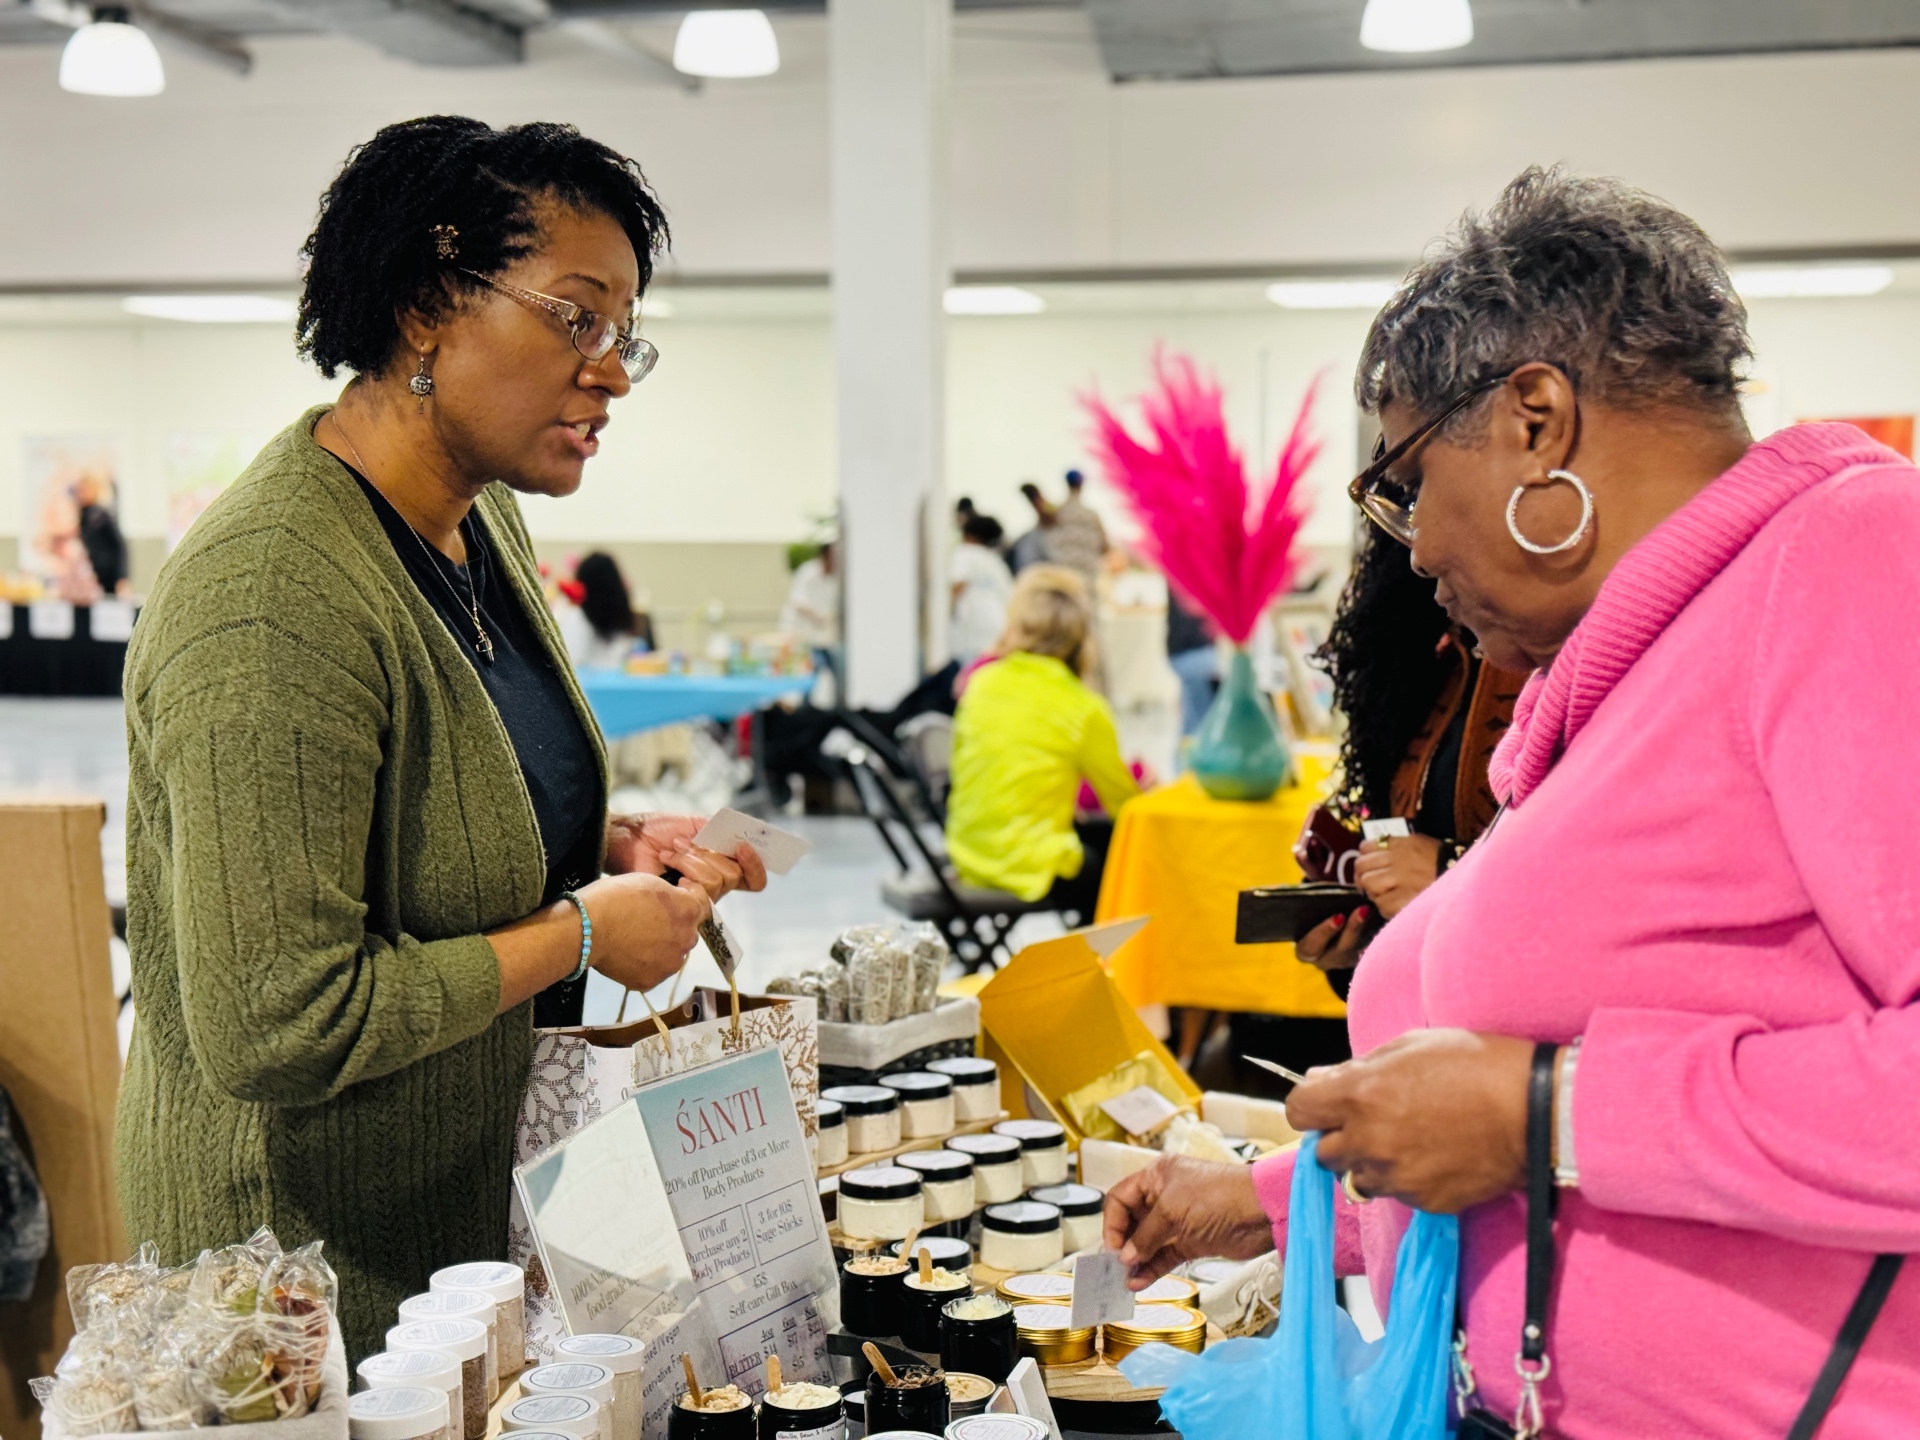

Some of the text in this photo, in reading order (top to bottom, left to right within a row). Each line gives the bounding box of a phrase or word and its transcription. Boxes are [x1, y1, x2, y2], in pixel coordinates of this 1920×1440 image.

[665, 1139, 790, 1196] 20% off Purchase of 3 or More
[702, 1167, 765, 1200] Body Products
[697, 1218, 729, 1242] 10% off
[755, 1214, 804, 1245] Sage Sticks
[758, 1211, 765, 1224] 3
[766, 1207, 778, 1221] for
[686, 1227, 748, 1264] Purchase any 2
[692, 1249, 751, 1282] Body Products
[729, 1279, 799, 1320] Self-care Gift Box
[643, 1364, 672, 1397] eservative
[728, 1352, 762, 1378] BUTTER
